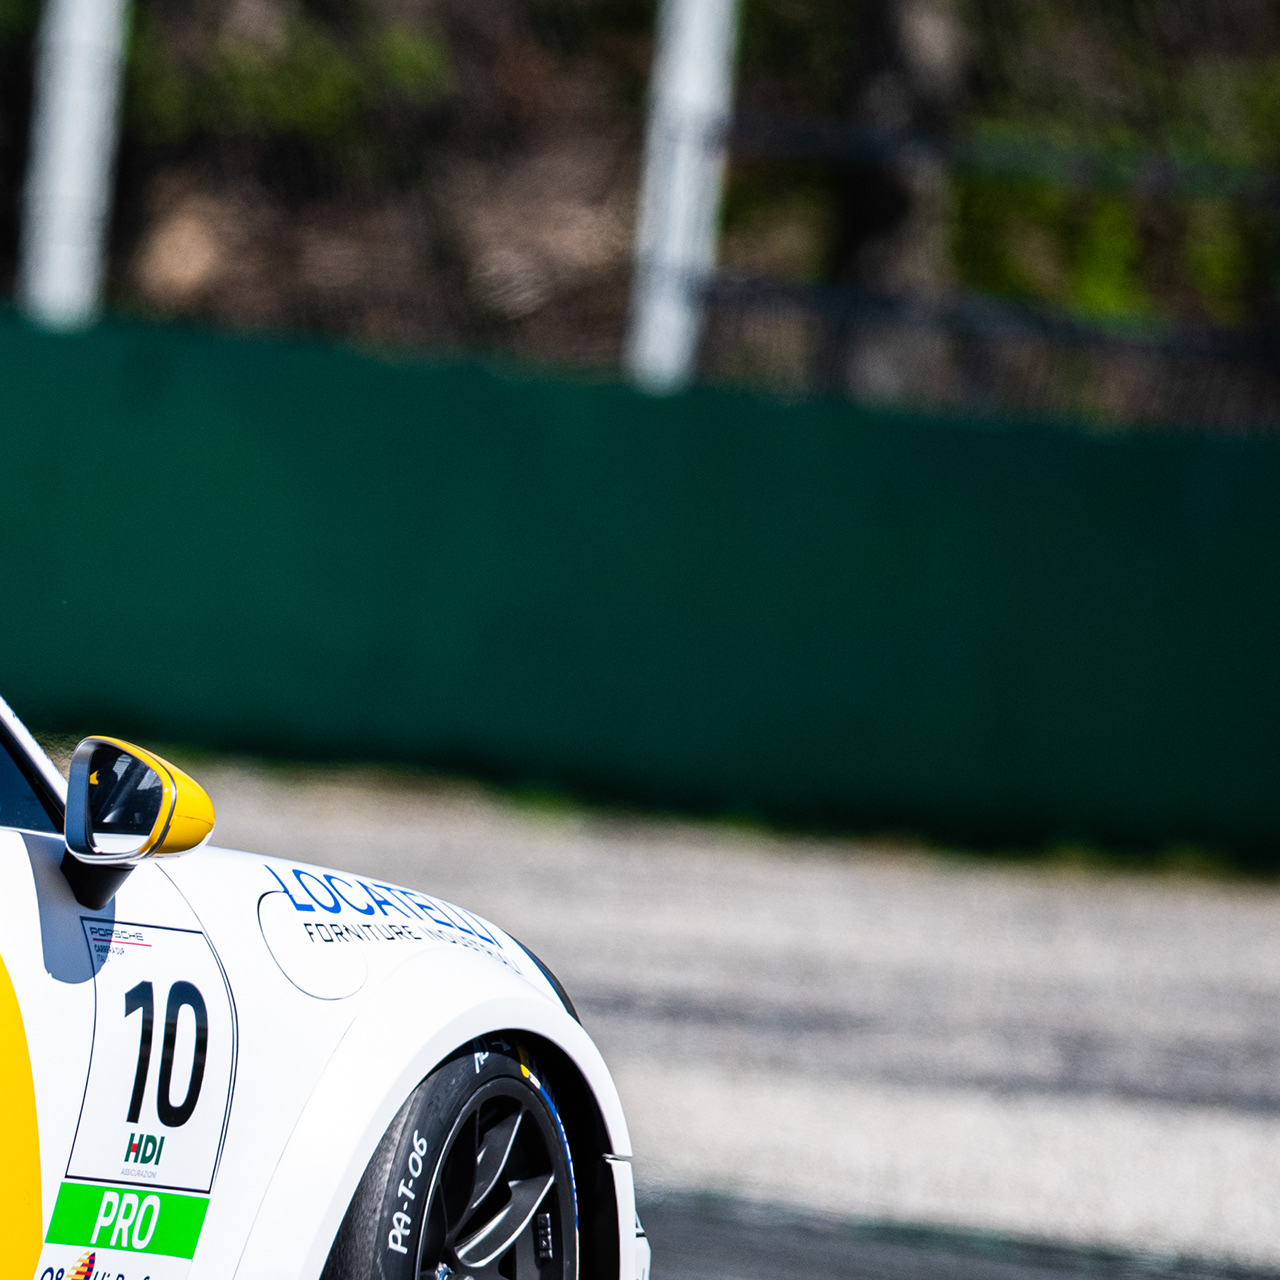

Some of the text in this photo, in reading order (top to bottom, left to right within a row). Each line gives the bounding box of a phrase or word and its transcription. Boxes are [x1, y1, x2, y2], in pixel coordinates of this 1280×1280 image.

[263, 864, 505, 950] LOCATELLI
[89, 926, 145, 941] PORSCHE
[302, 922, 423, 943] FORNITURE
[124, 979, 209, 1128] 10
[124, 1132, 166, 1166] HDI
[90, 1190, 162, 1250] PRO
